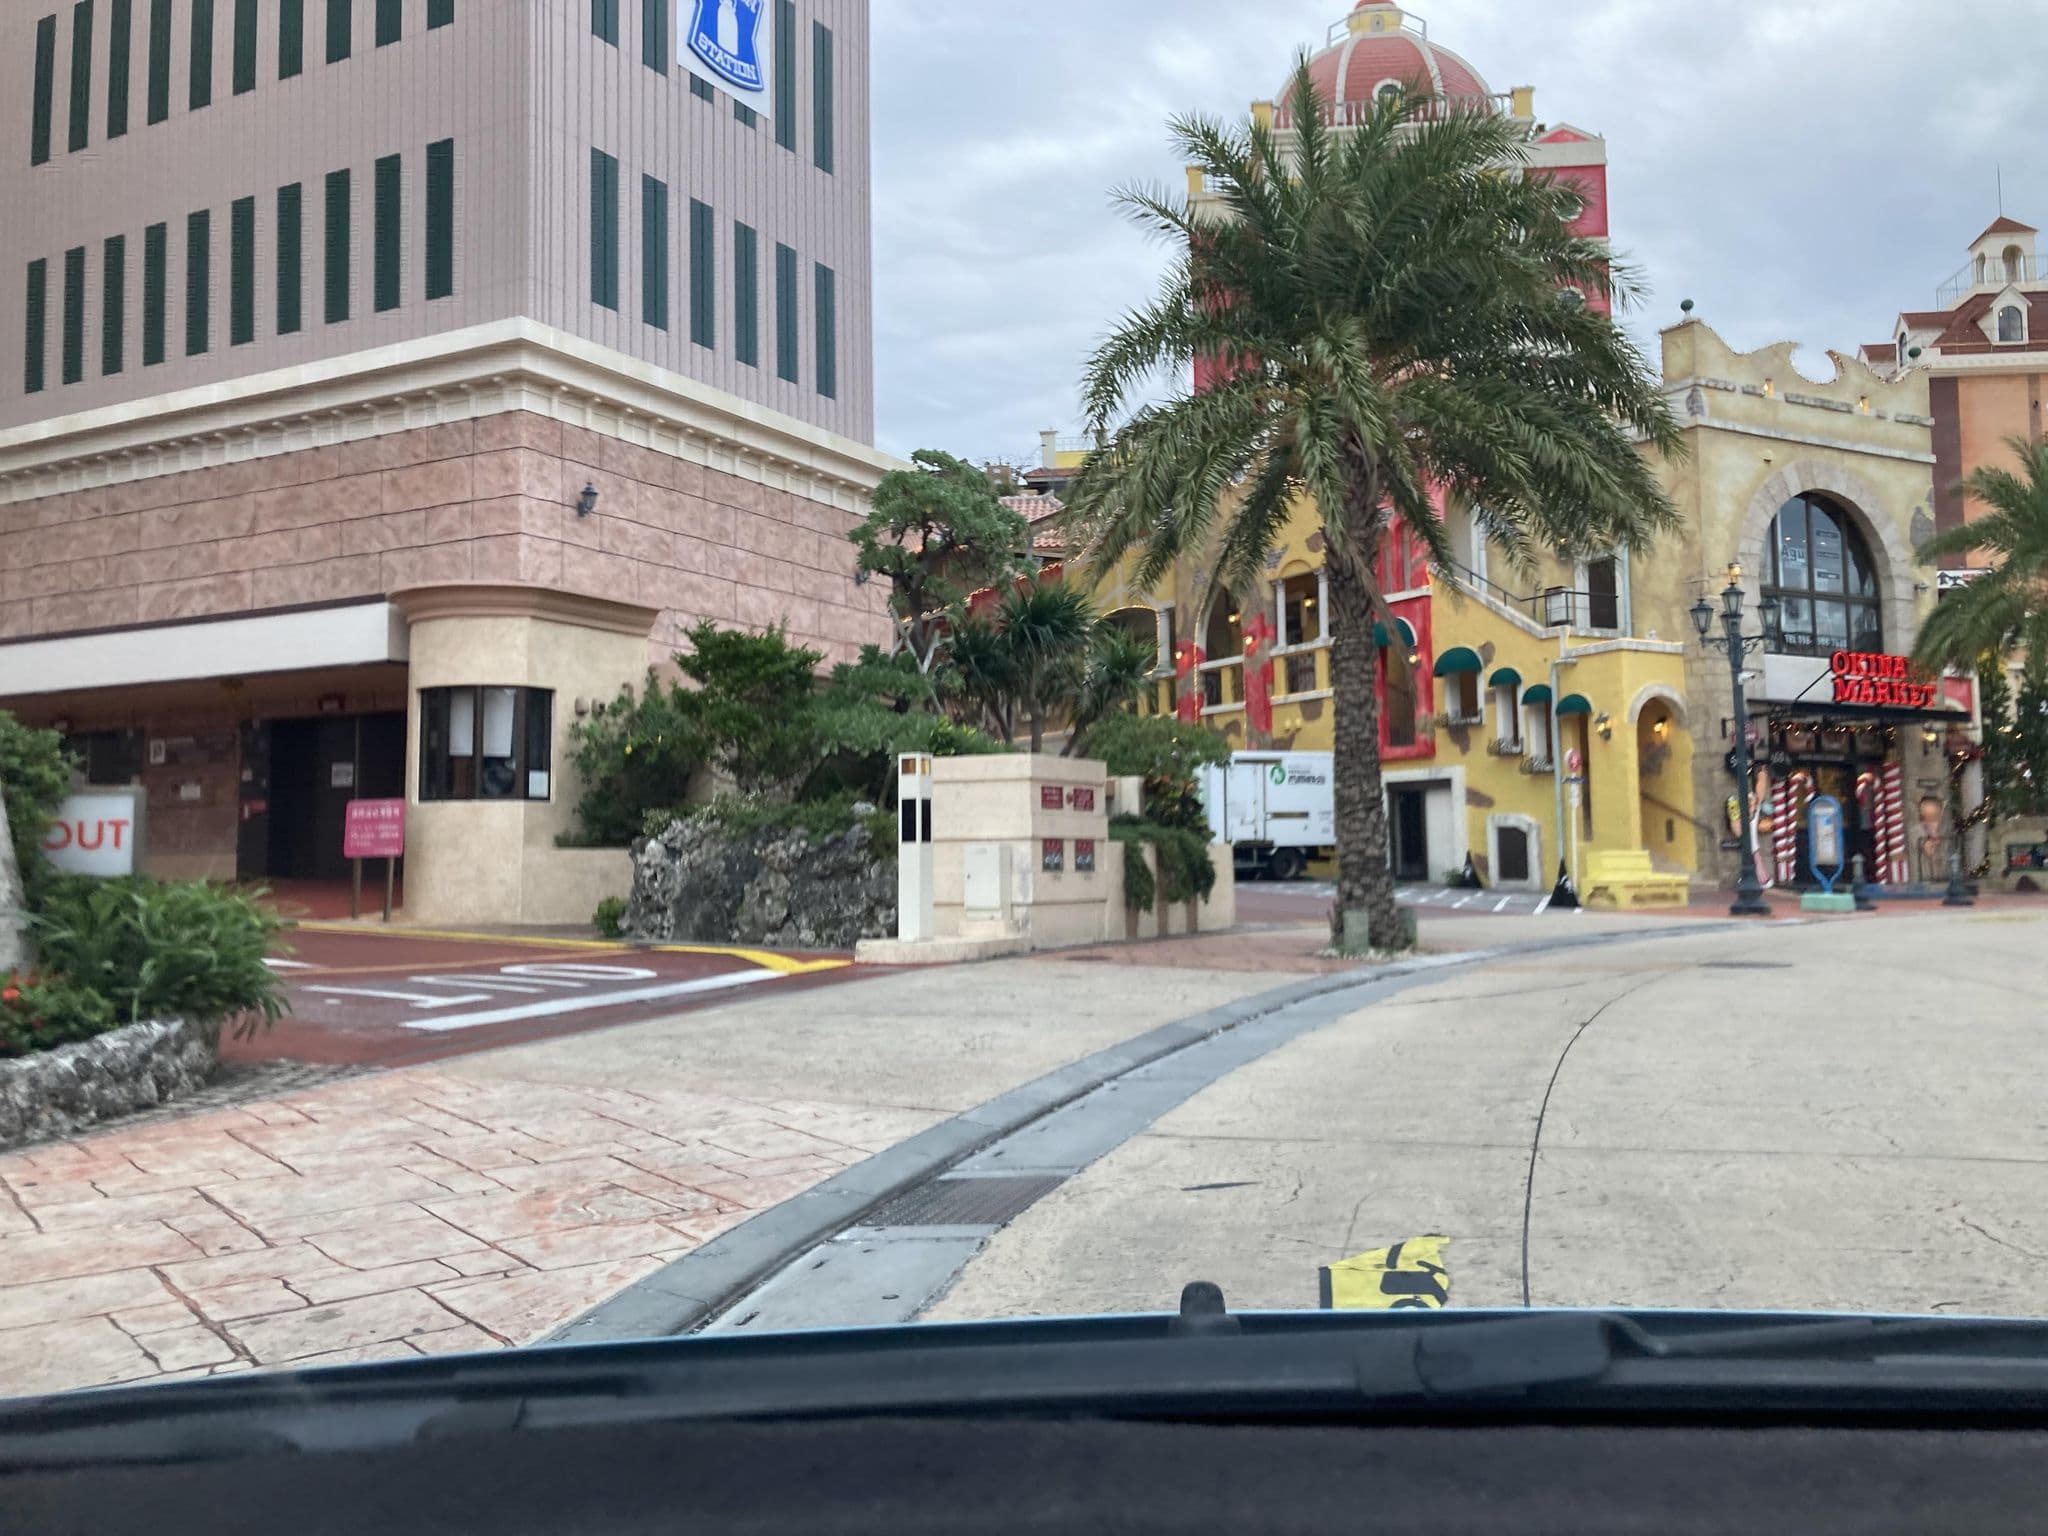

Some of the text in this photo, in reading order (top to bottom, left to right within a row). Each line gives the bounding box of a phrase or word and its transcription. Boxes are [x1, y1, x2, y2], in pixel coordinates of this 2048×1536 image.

[698, 32, 758, 81] STATION
[1832, 676, 1937, 709] MARKET
[43, 819, 129, 852] OUT
